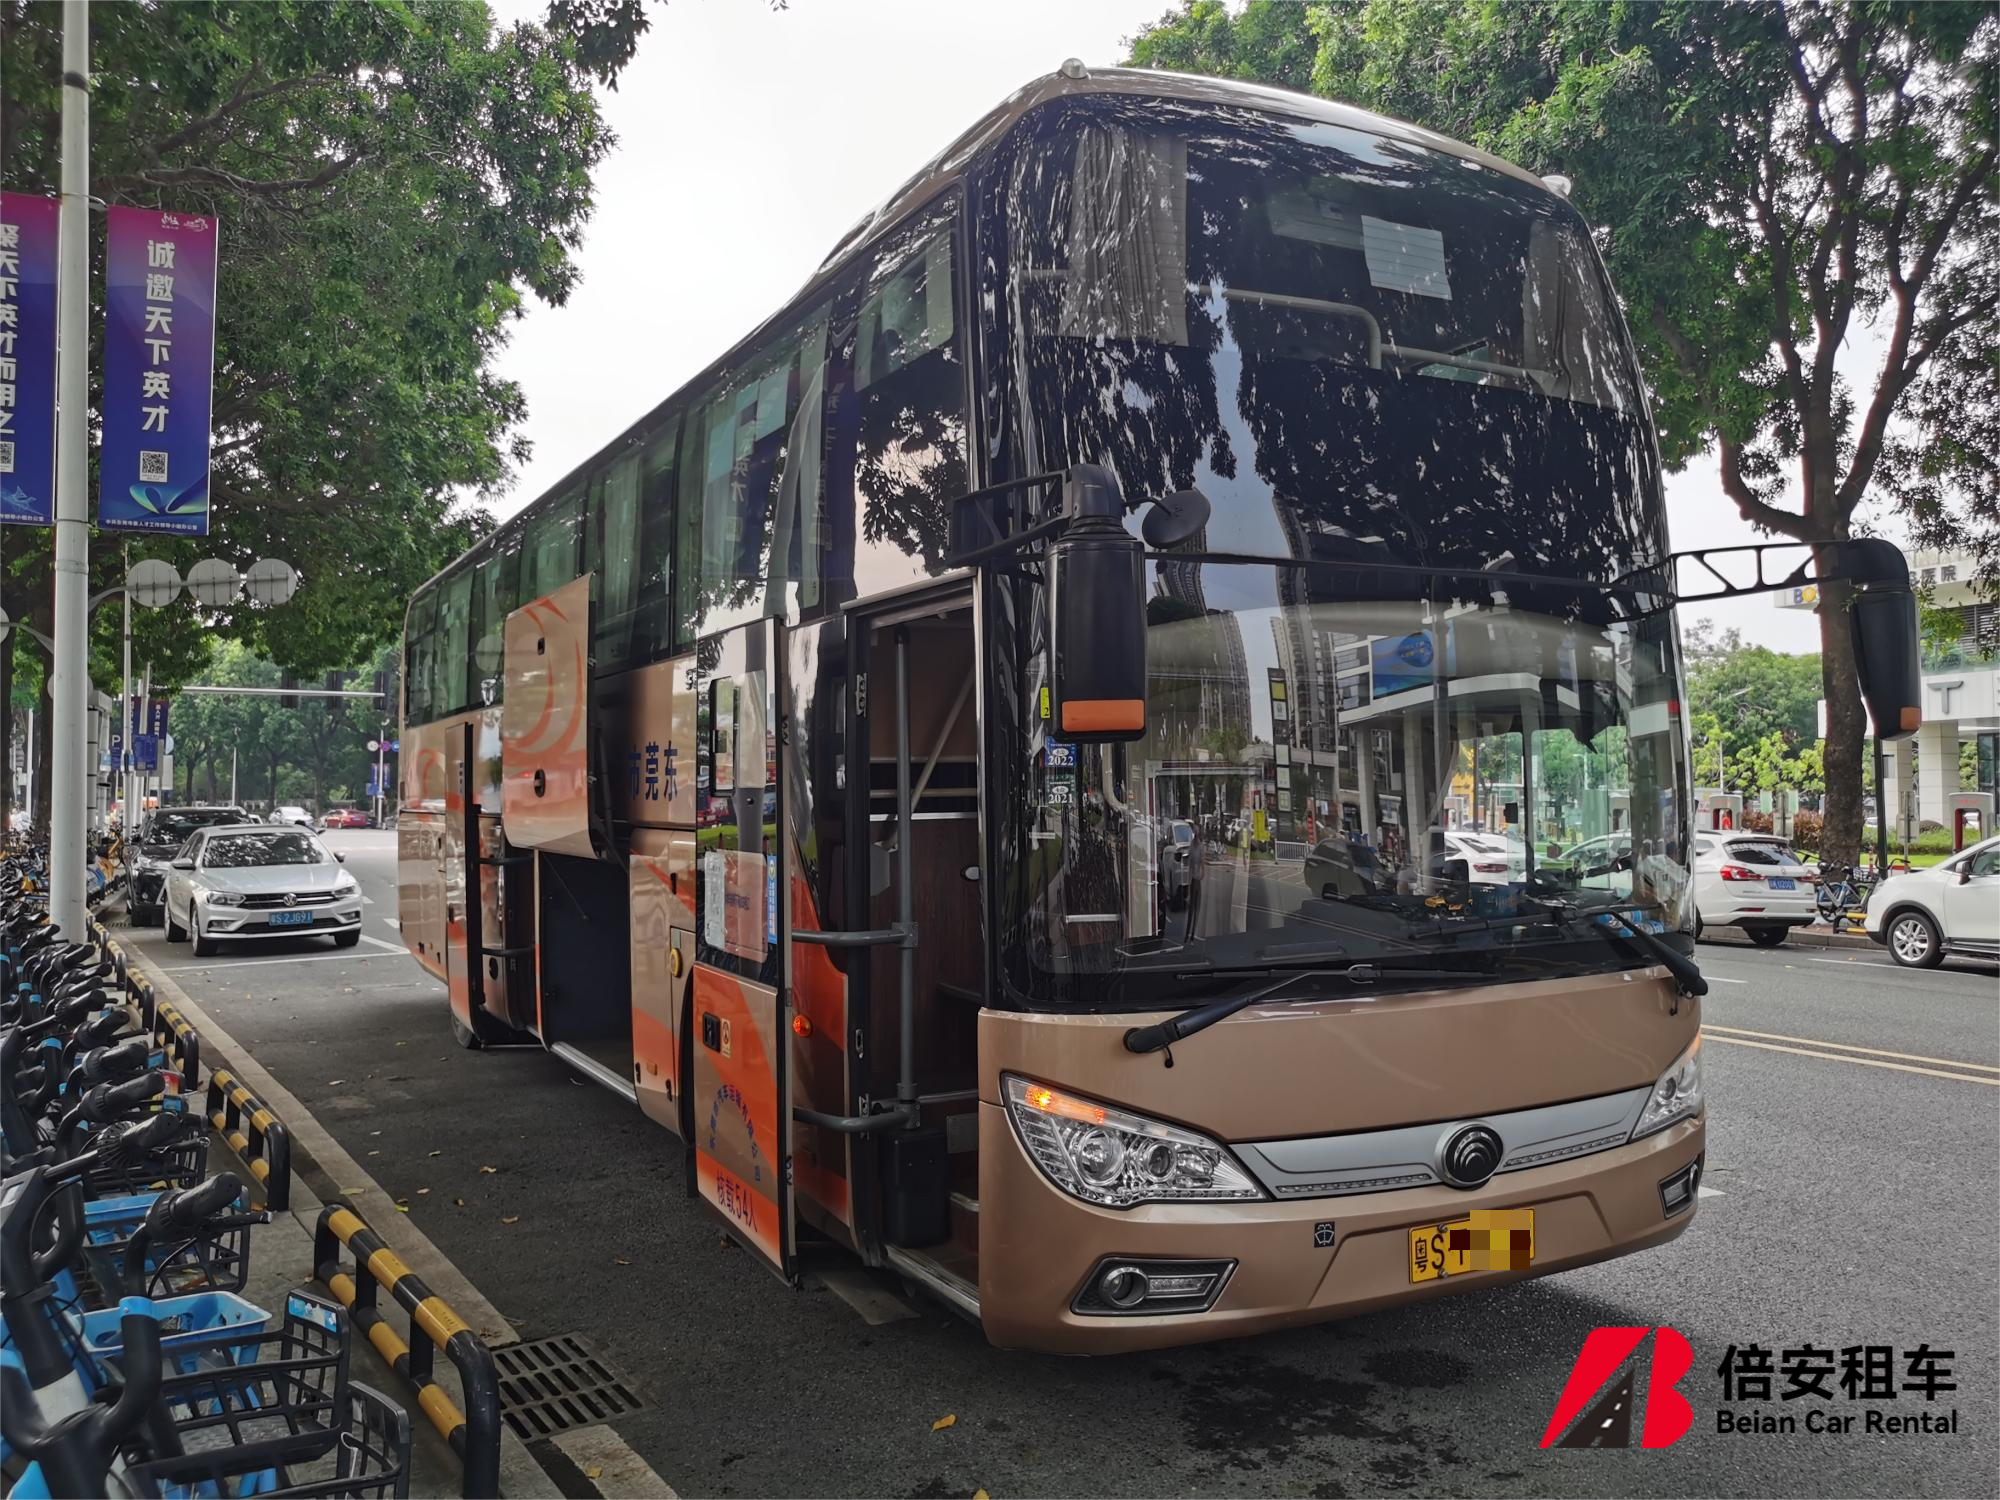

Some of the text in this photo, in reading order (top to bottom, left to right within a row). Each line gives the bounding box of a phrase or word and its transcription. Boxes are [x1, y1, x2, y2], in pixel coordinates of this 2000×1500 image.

[142, 239, 176, 433] 诚邀天下英才
[1048, 755, 1074, 766] 2022
[1048, 793, 1073, 804] 2021
[715, 1169, 758, 1233] 核载54人
